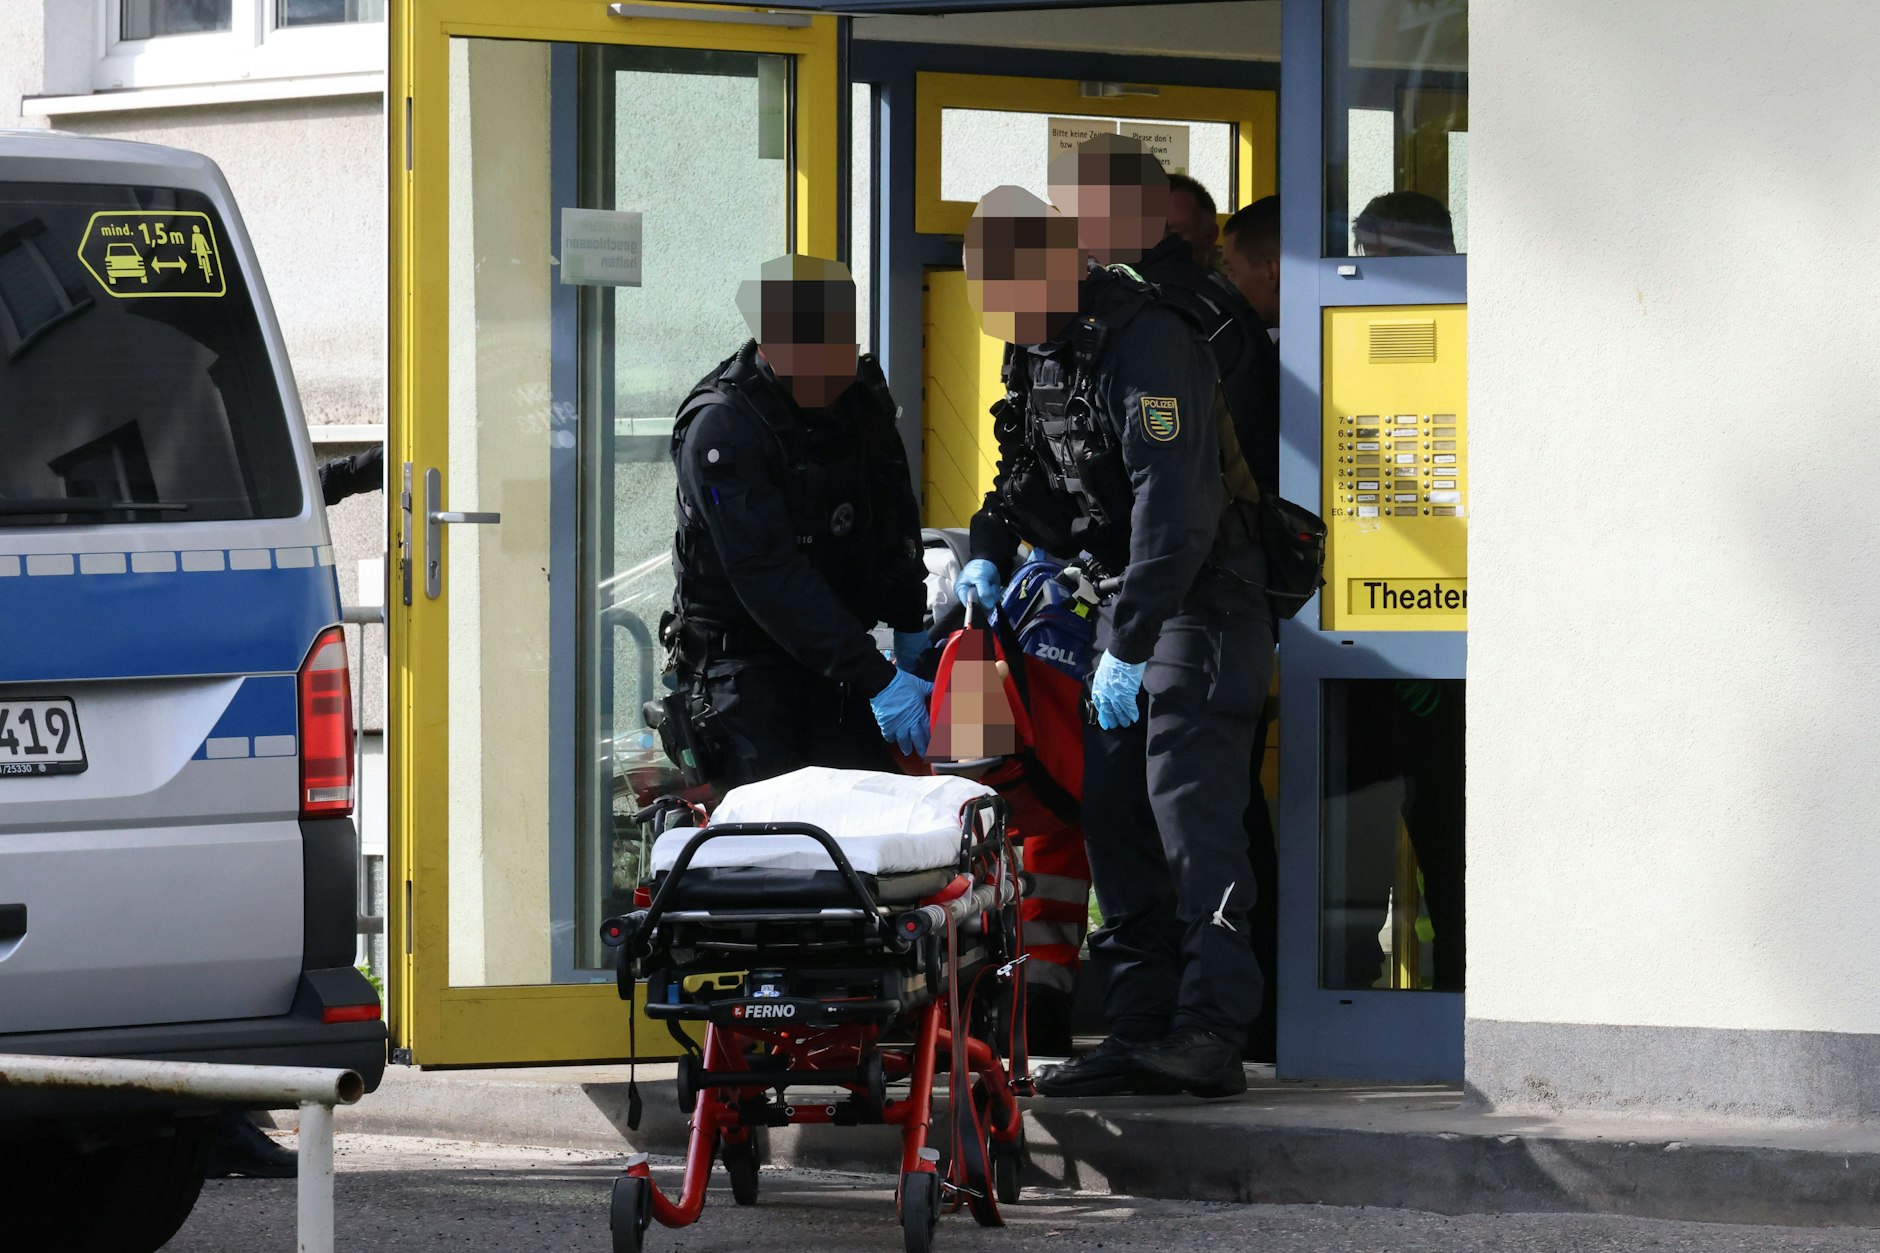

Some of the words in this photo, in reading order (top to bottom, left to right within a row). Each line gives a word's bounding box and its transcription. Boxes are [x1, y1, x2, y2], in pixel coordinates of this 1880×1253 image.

[1052, 128, 1069, 138] Bitte
[1070, 130, 1088, 139] keine
[100, 223, 134, 237] mind.
[1144, 399, 1175, 409] POLIZEI
[1363, 582, 1467, 609] Theater
[1035, 643, 1076, 666] ZOLL
[0, 707, 71, 756] 419
[744, 1004, 796, 1019] FERNO
